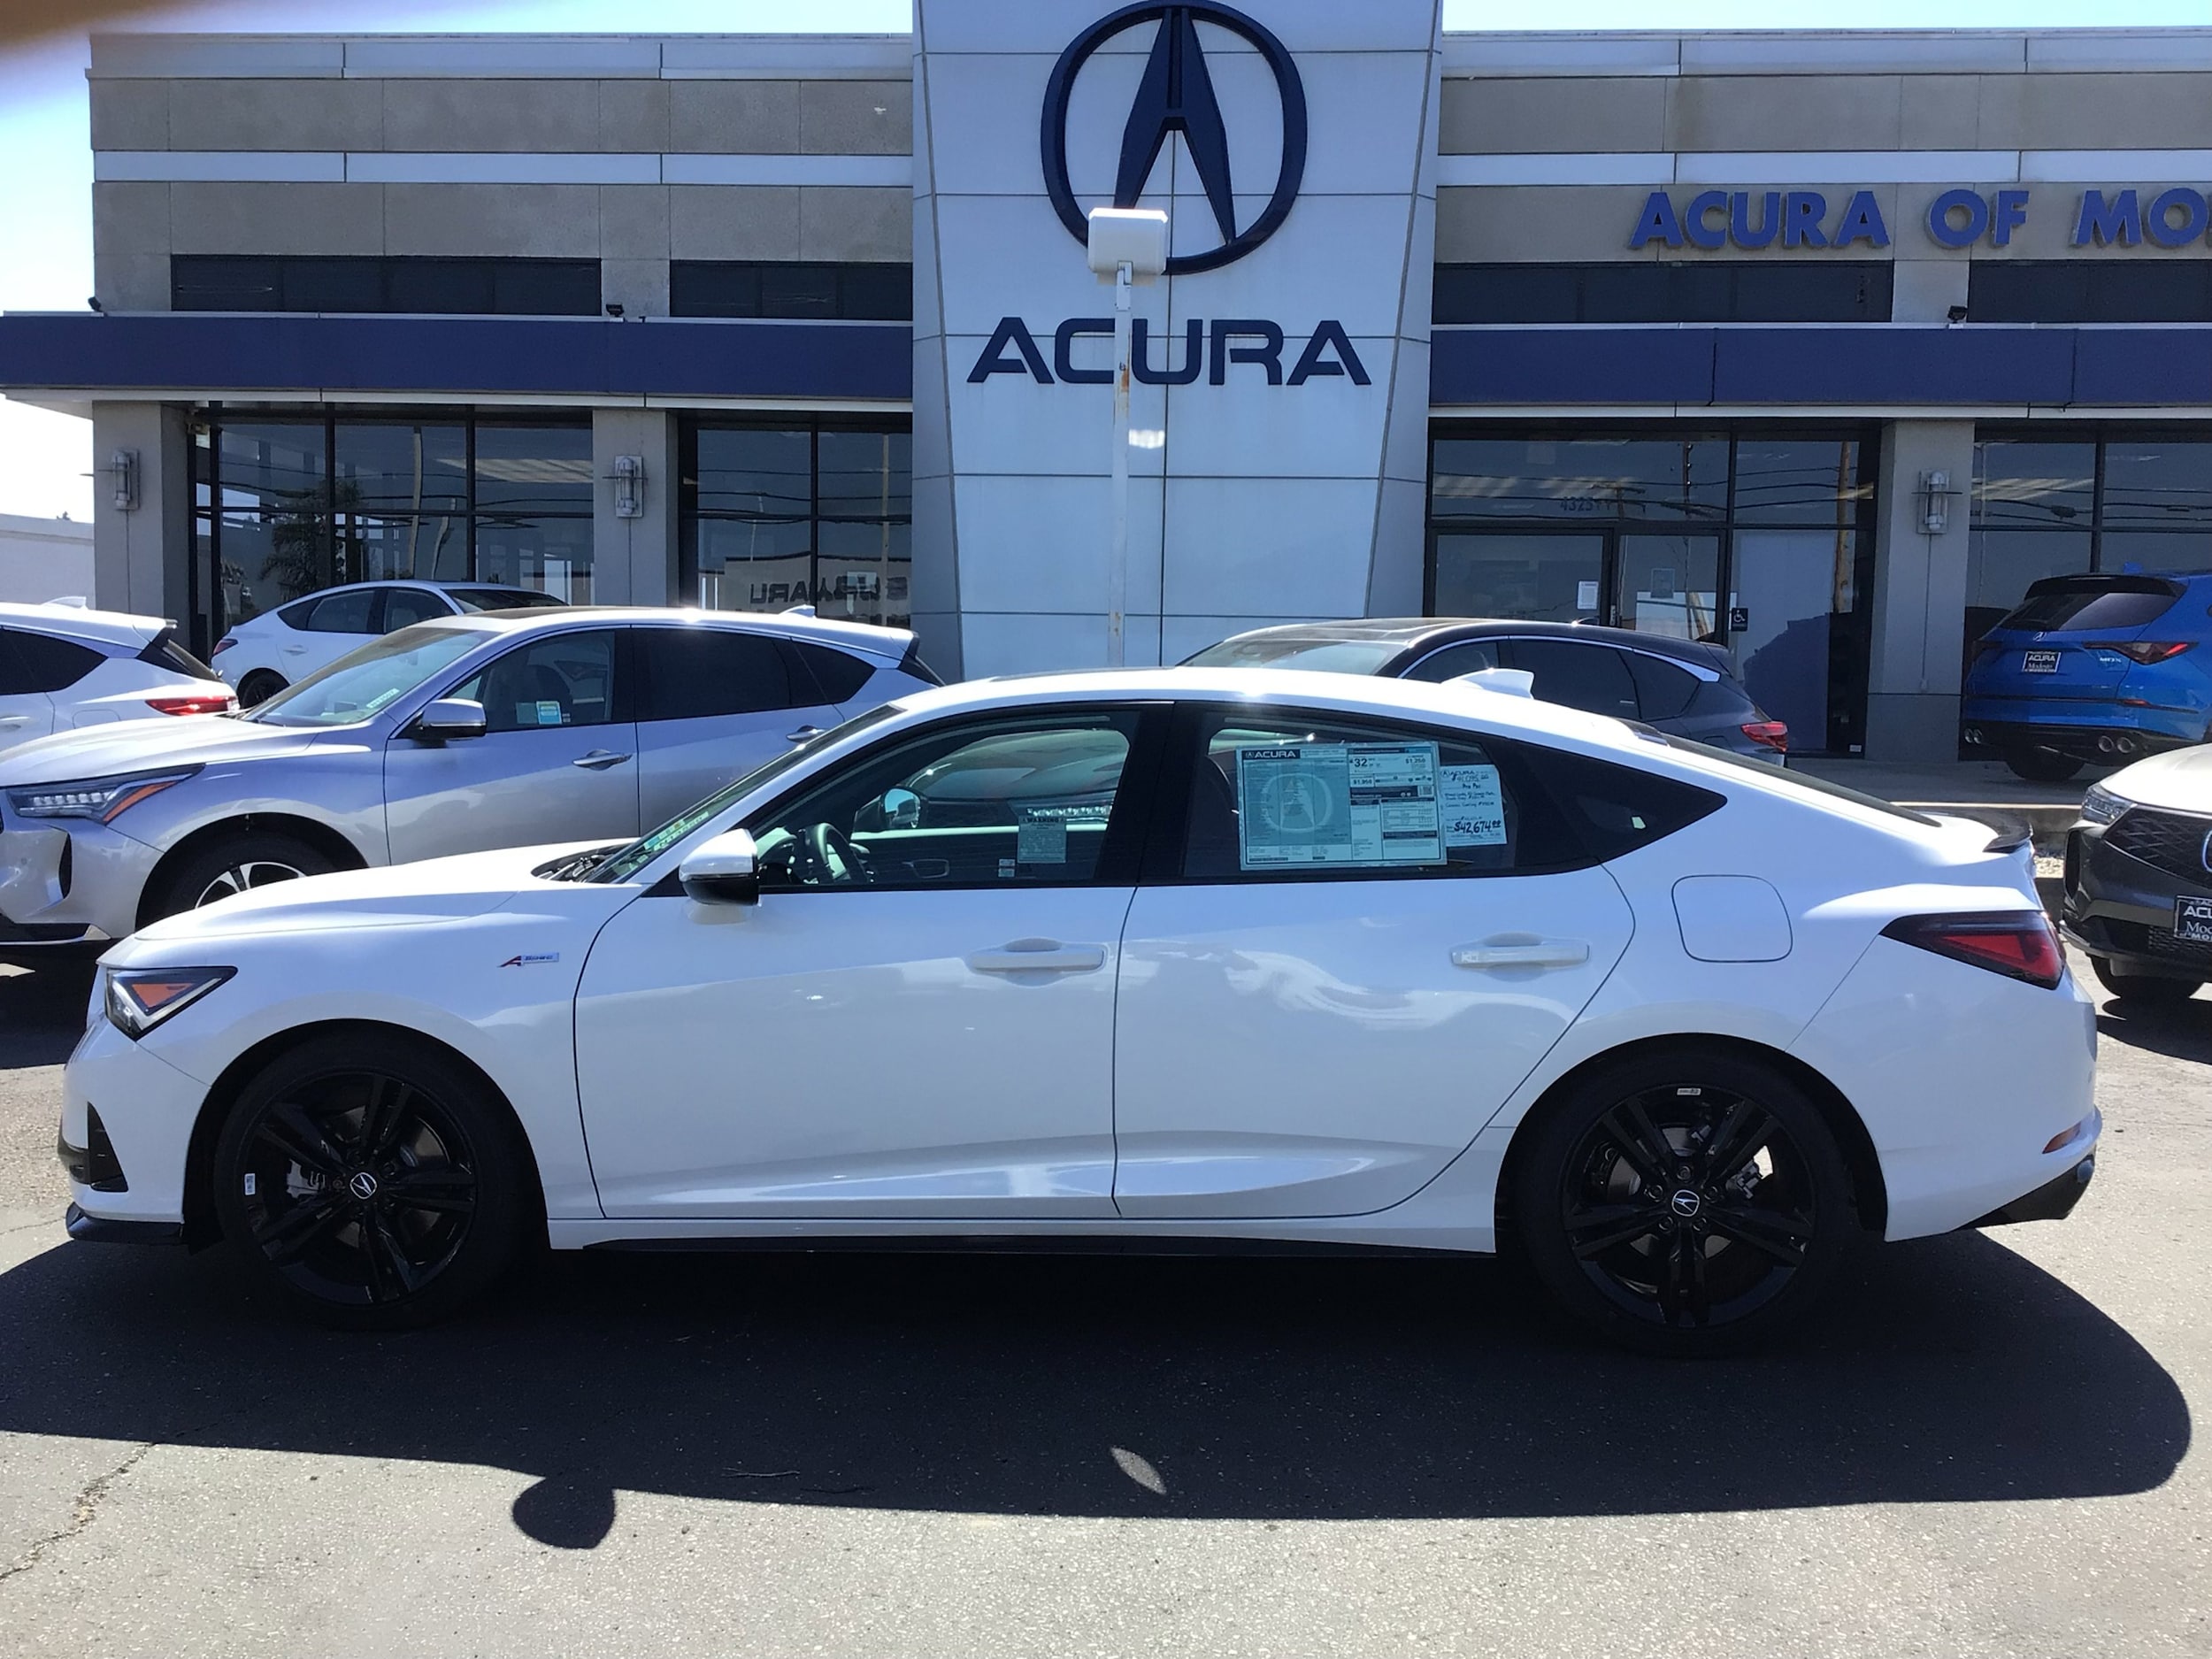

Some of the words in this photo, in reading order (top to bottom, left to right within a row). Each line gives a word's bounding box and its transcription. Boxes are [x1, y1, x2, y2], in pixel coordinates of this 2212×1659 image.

[1628, 190, 1891, 249] ACURA
[1927, 188, 2030, 248] OF
[2070, 188, 2212, 249] MO
[967, 317, 1371, 386] ACURA
[1354, 758, 1368, 767] 32
